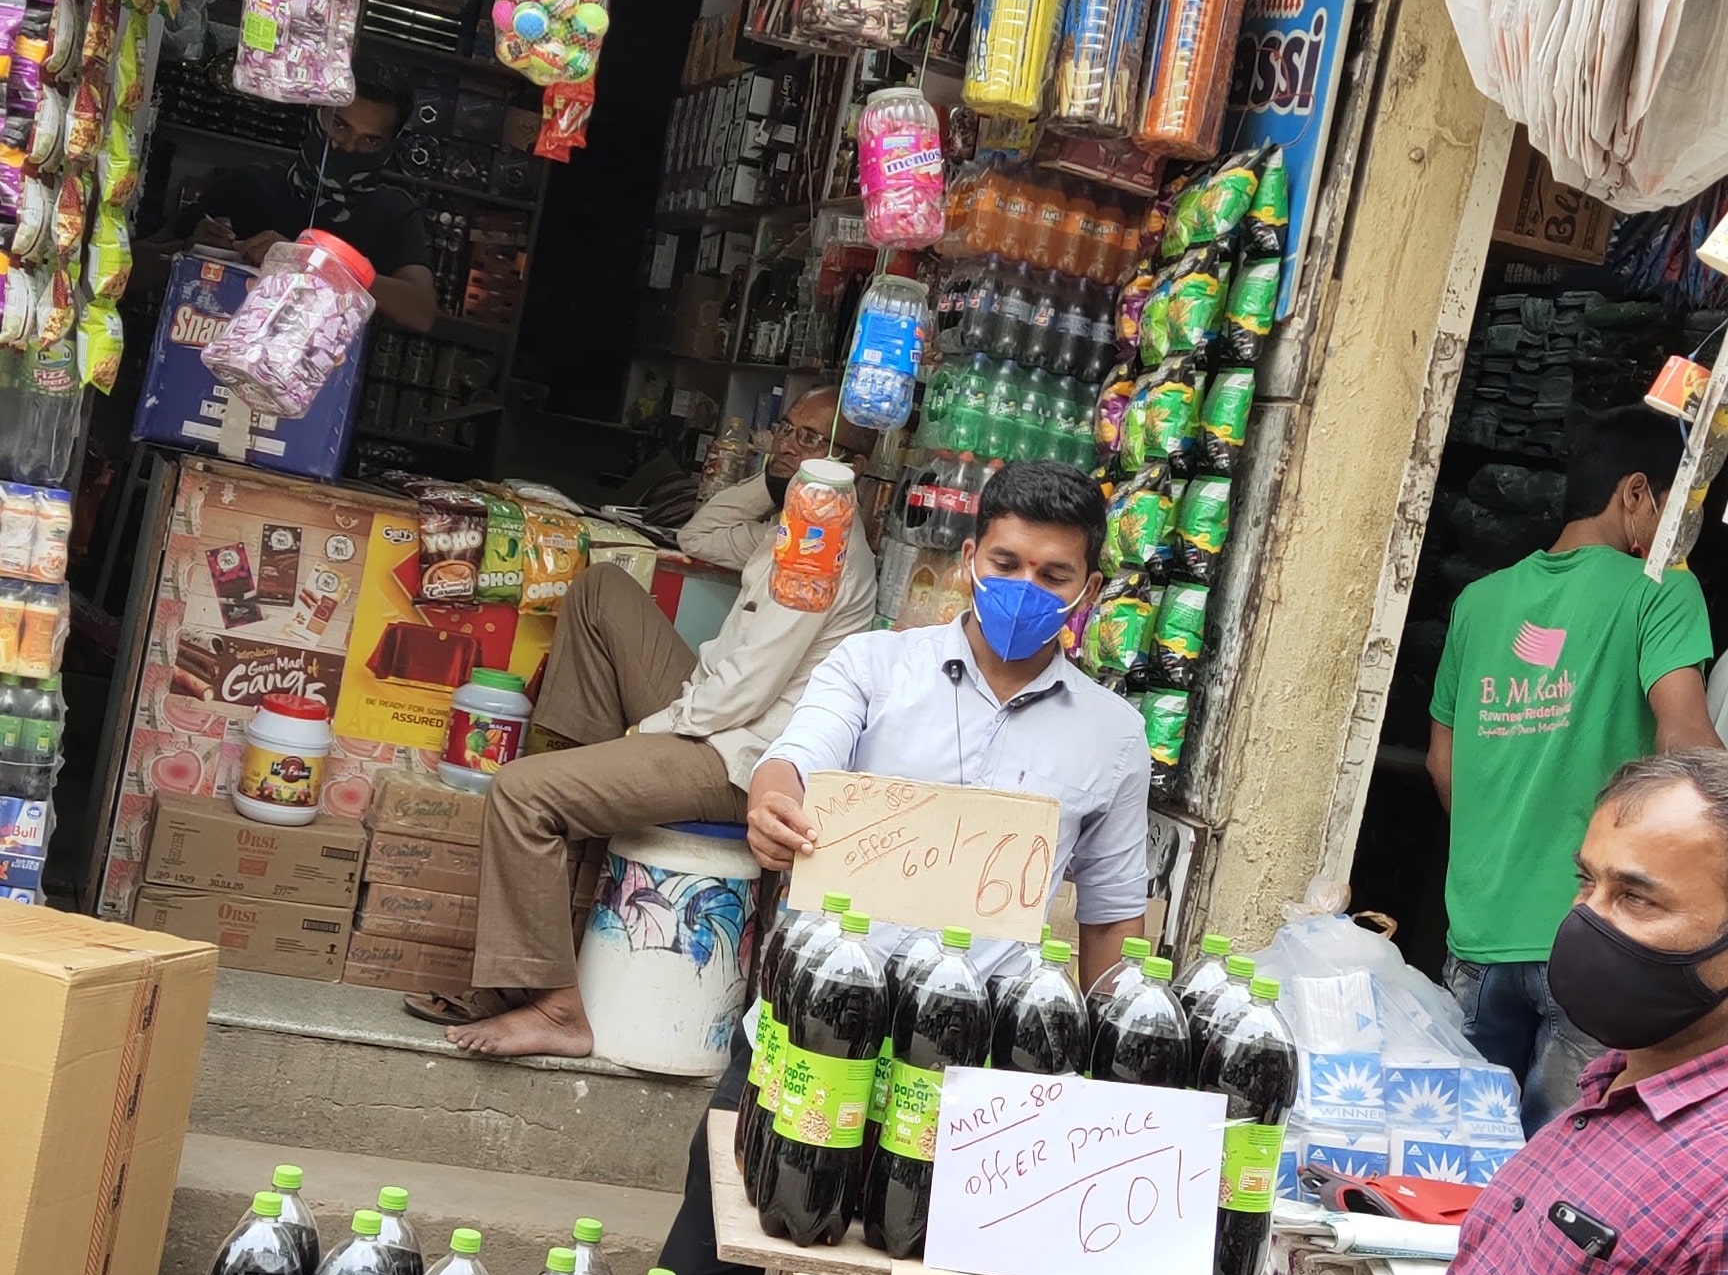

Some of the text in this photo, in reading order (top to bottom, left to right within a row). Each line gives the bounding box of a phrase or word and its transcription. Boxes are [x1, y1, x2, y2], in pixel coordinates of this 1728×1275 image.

[1228, 7, 1328, 116] assi
[884, 149, 942, 175] mentos
[247, 651, 306, 676] Gone Mad
[221, 657, 320, 702] Gang of
[366, 697, 376, 706] BE
[379, 699, 406, 710] READY
[407, 703, 425, 713] FOR
[391, 712, 444, 728] ASSURED
[12, 825, 37, 839] Bull
[236, 828, 279, 850] ORSL
[976, 831, 1050, 917] 60
[218, 902, 260, 924] ORSL
